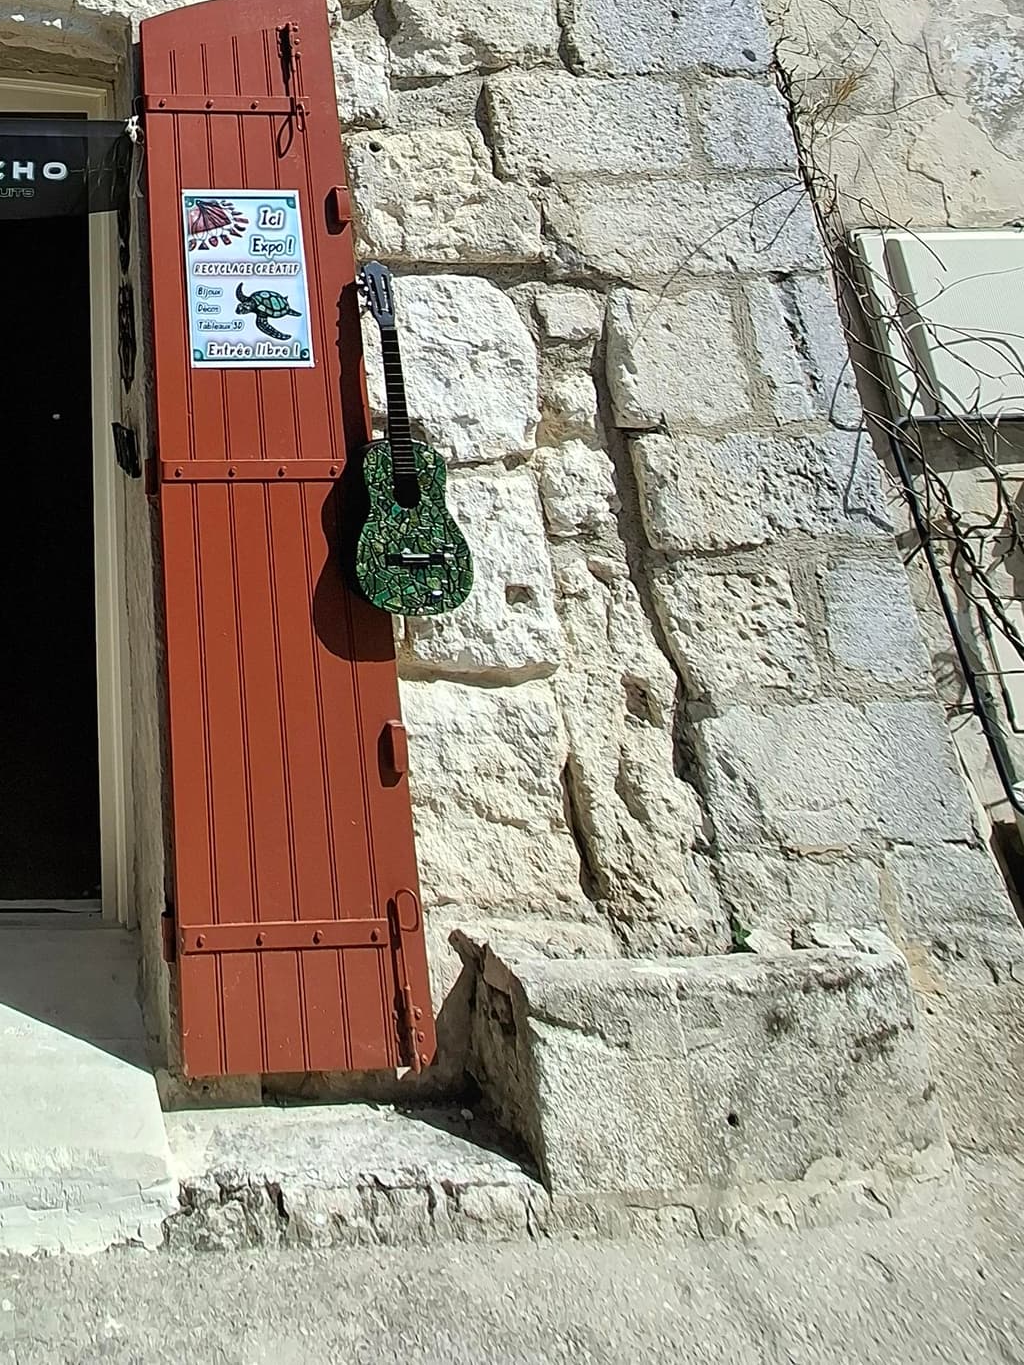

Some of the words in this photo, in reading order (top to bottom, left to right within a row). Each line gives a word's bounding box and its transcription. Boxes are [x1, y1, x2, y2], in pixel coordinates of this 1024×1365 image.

[261, 209, 282, 226] Ici
[252, 237, 284, 256] Expo
[194, 263, 252, 275] RECYCLAGE
[255, 260, 300, 275] CRÉATIF
[197, 286, 222, 298] Bijoux
[198, 321, 231, 331] Tableaux
[232, 321, 244, 331] 3D
[207, 343, 252, 356] Entrée
[257, 343, 290, 357] libre
